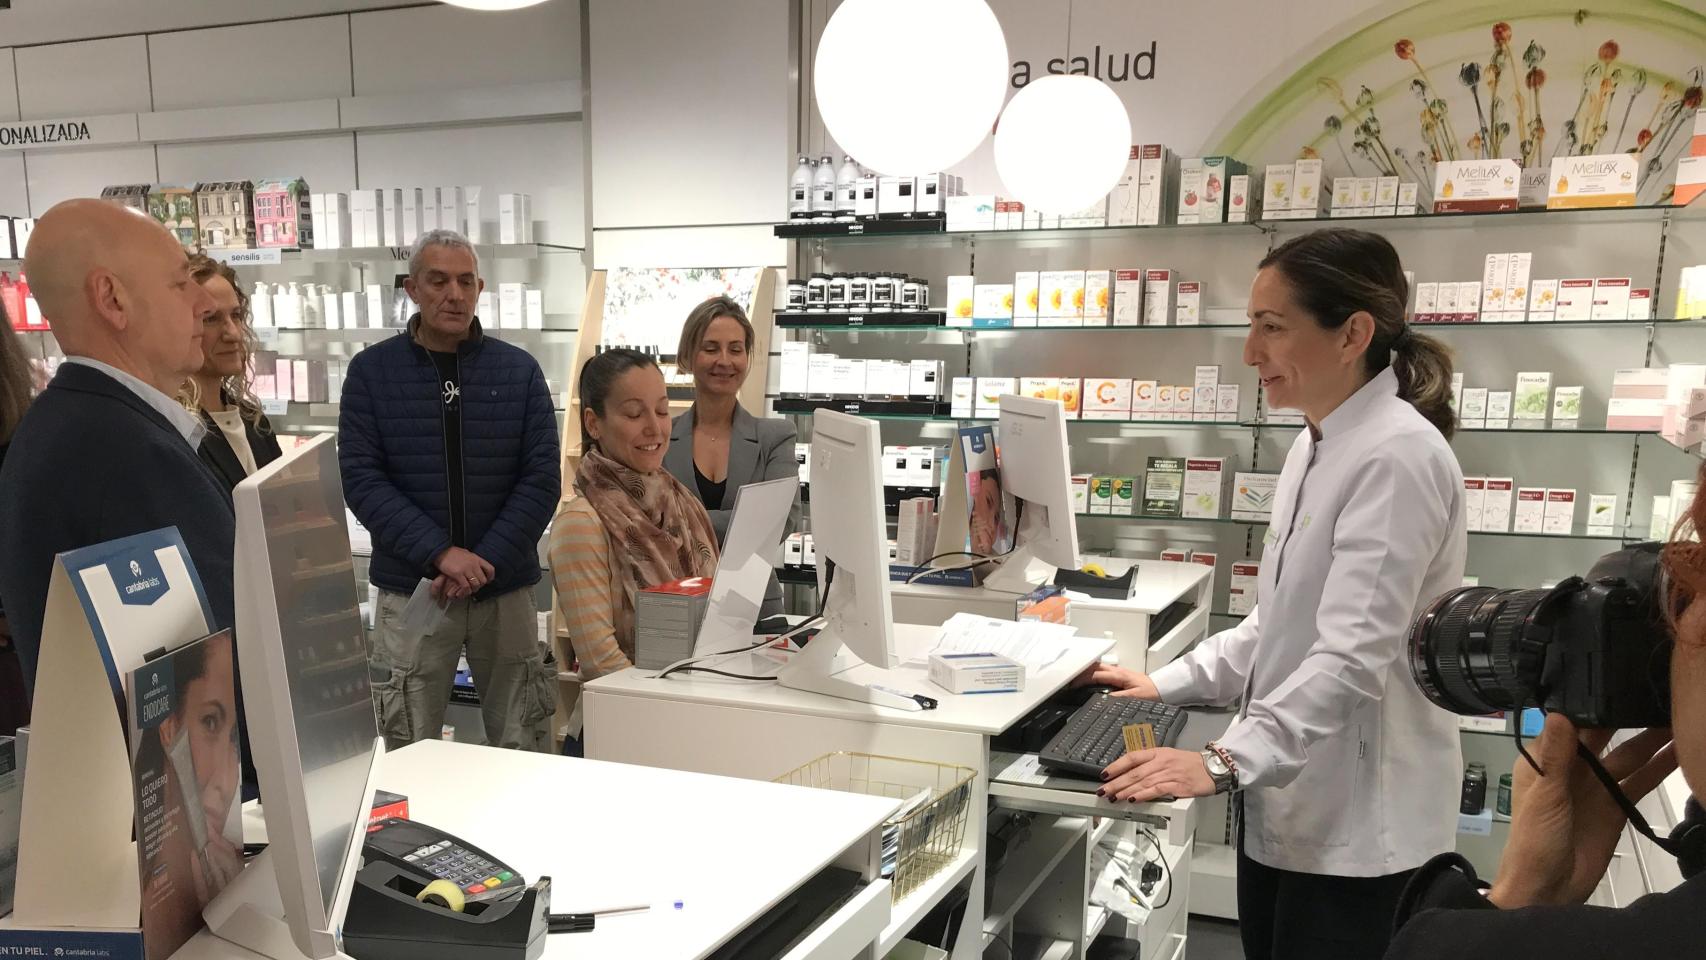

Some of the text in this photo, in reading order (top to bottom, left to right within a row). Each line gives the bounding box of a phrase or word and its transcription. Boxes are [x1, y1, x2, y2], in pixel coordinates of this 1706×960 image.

[1047, 41, 1157, 82] salud
[0, 122, 91, 146] ONALIZADA
[231, 253, 260, 261] sensilis
[148, 774, 168, 794] QUIERO
[142, 793, 157, 810] TODO
[10, 946, 23, 956] TU
[25, 946, 48, 956] PIEL.
[65, 948, 96, 957] cantabria
